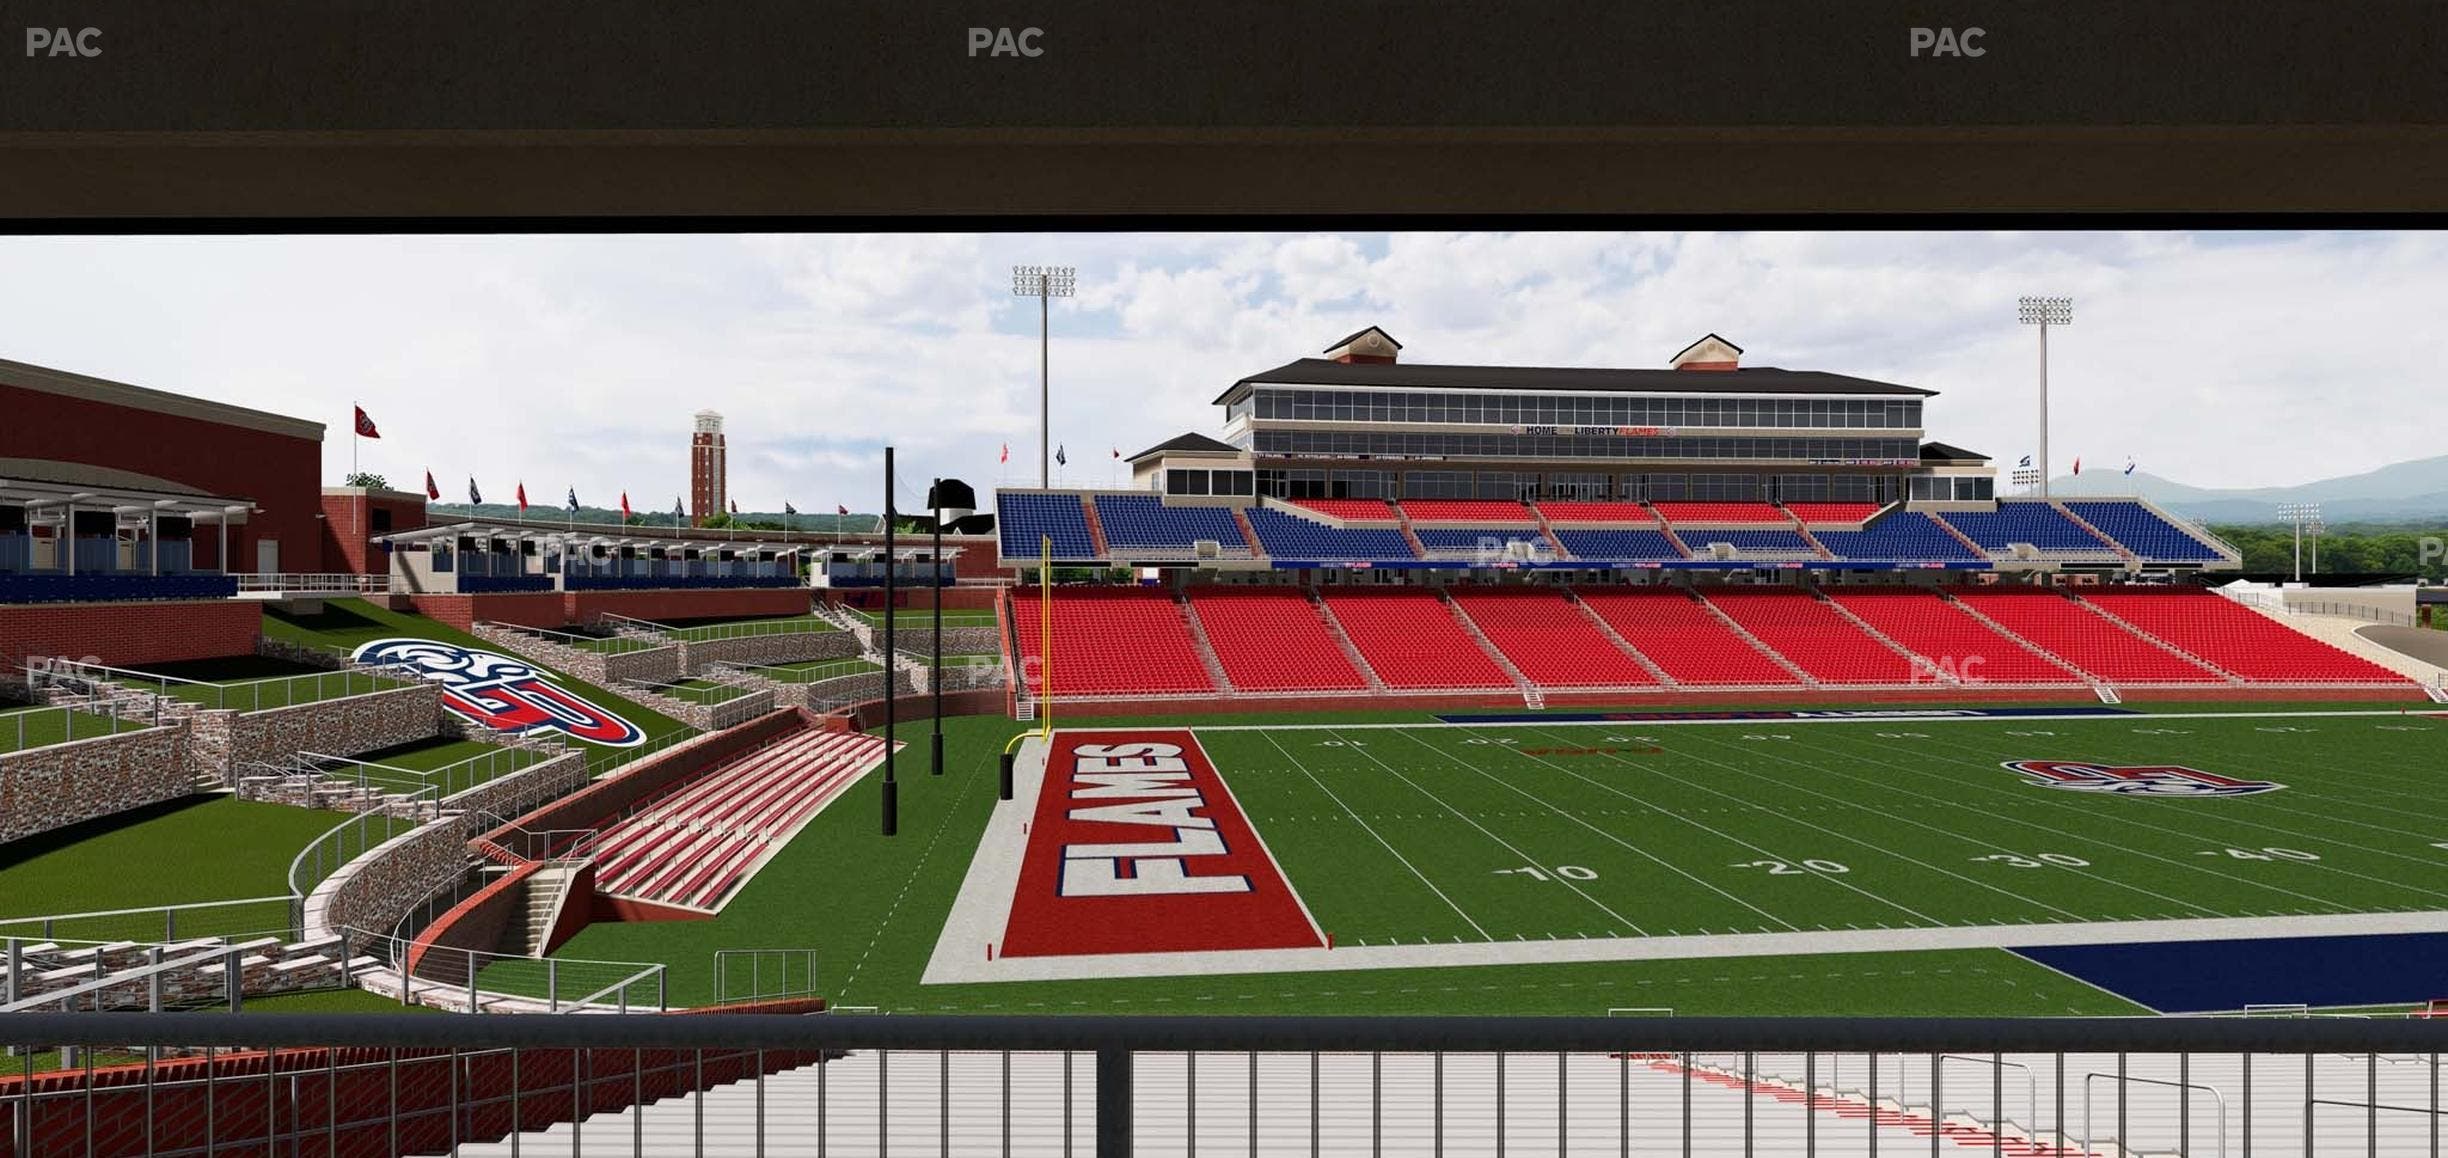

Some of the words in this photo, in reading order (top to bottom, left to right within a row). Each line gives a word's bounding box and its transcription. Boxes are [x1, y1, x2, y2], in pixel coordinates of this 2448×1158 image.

[1526, 426, 1558, 435] HOME
[1056, 742, 1255, 897] FLAMES
[1752, 860, 1850, 875] 20
[1989, 853, 2090, 868] 30
[1515, 866, 1599, 881] 10
